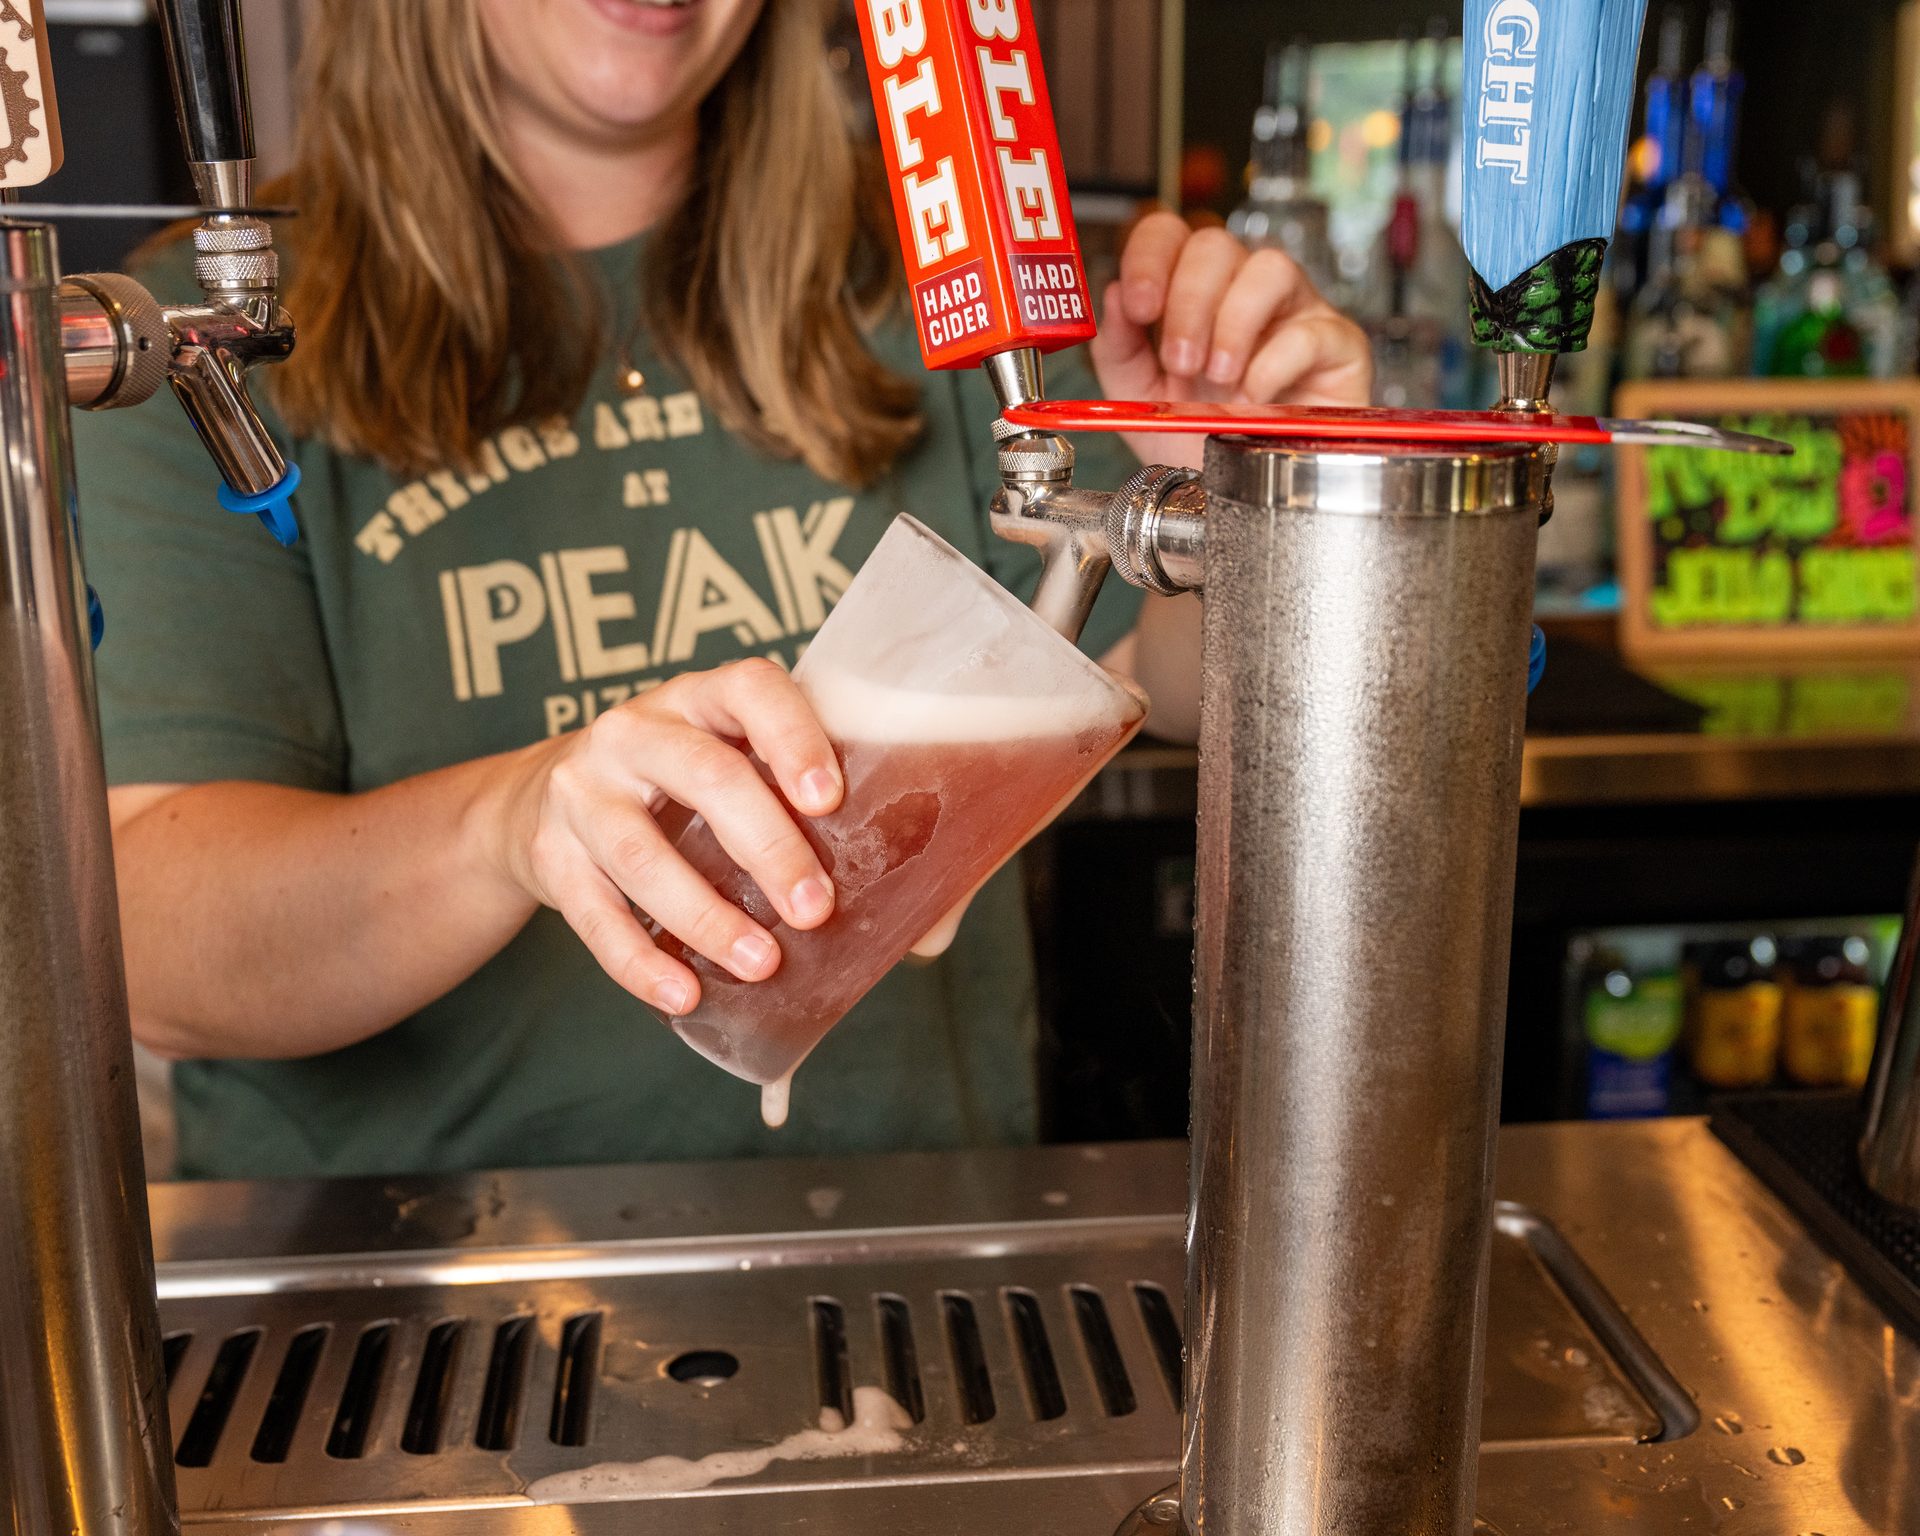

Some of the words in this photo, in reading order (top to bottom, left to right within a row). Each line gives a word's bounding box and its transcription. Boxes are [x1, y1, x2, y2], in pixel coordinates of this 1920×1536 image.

[1476, 0, 1540, 184] GHT
[922, 272, 982, 317] HARD
[1017, 264, 1075, 290] HARD
[929, 302, 990, 346] CIDER
[1024, 294, 1084, 321] CIDER
[594, 391, 704, 449] ARE
[623, 468, 671, 508] AT
[439, 497, 856, 702] PEAK
